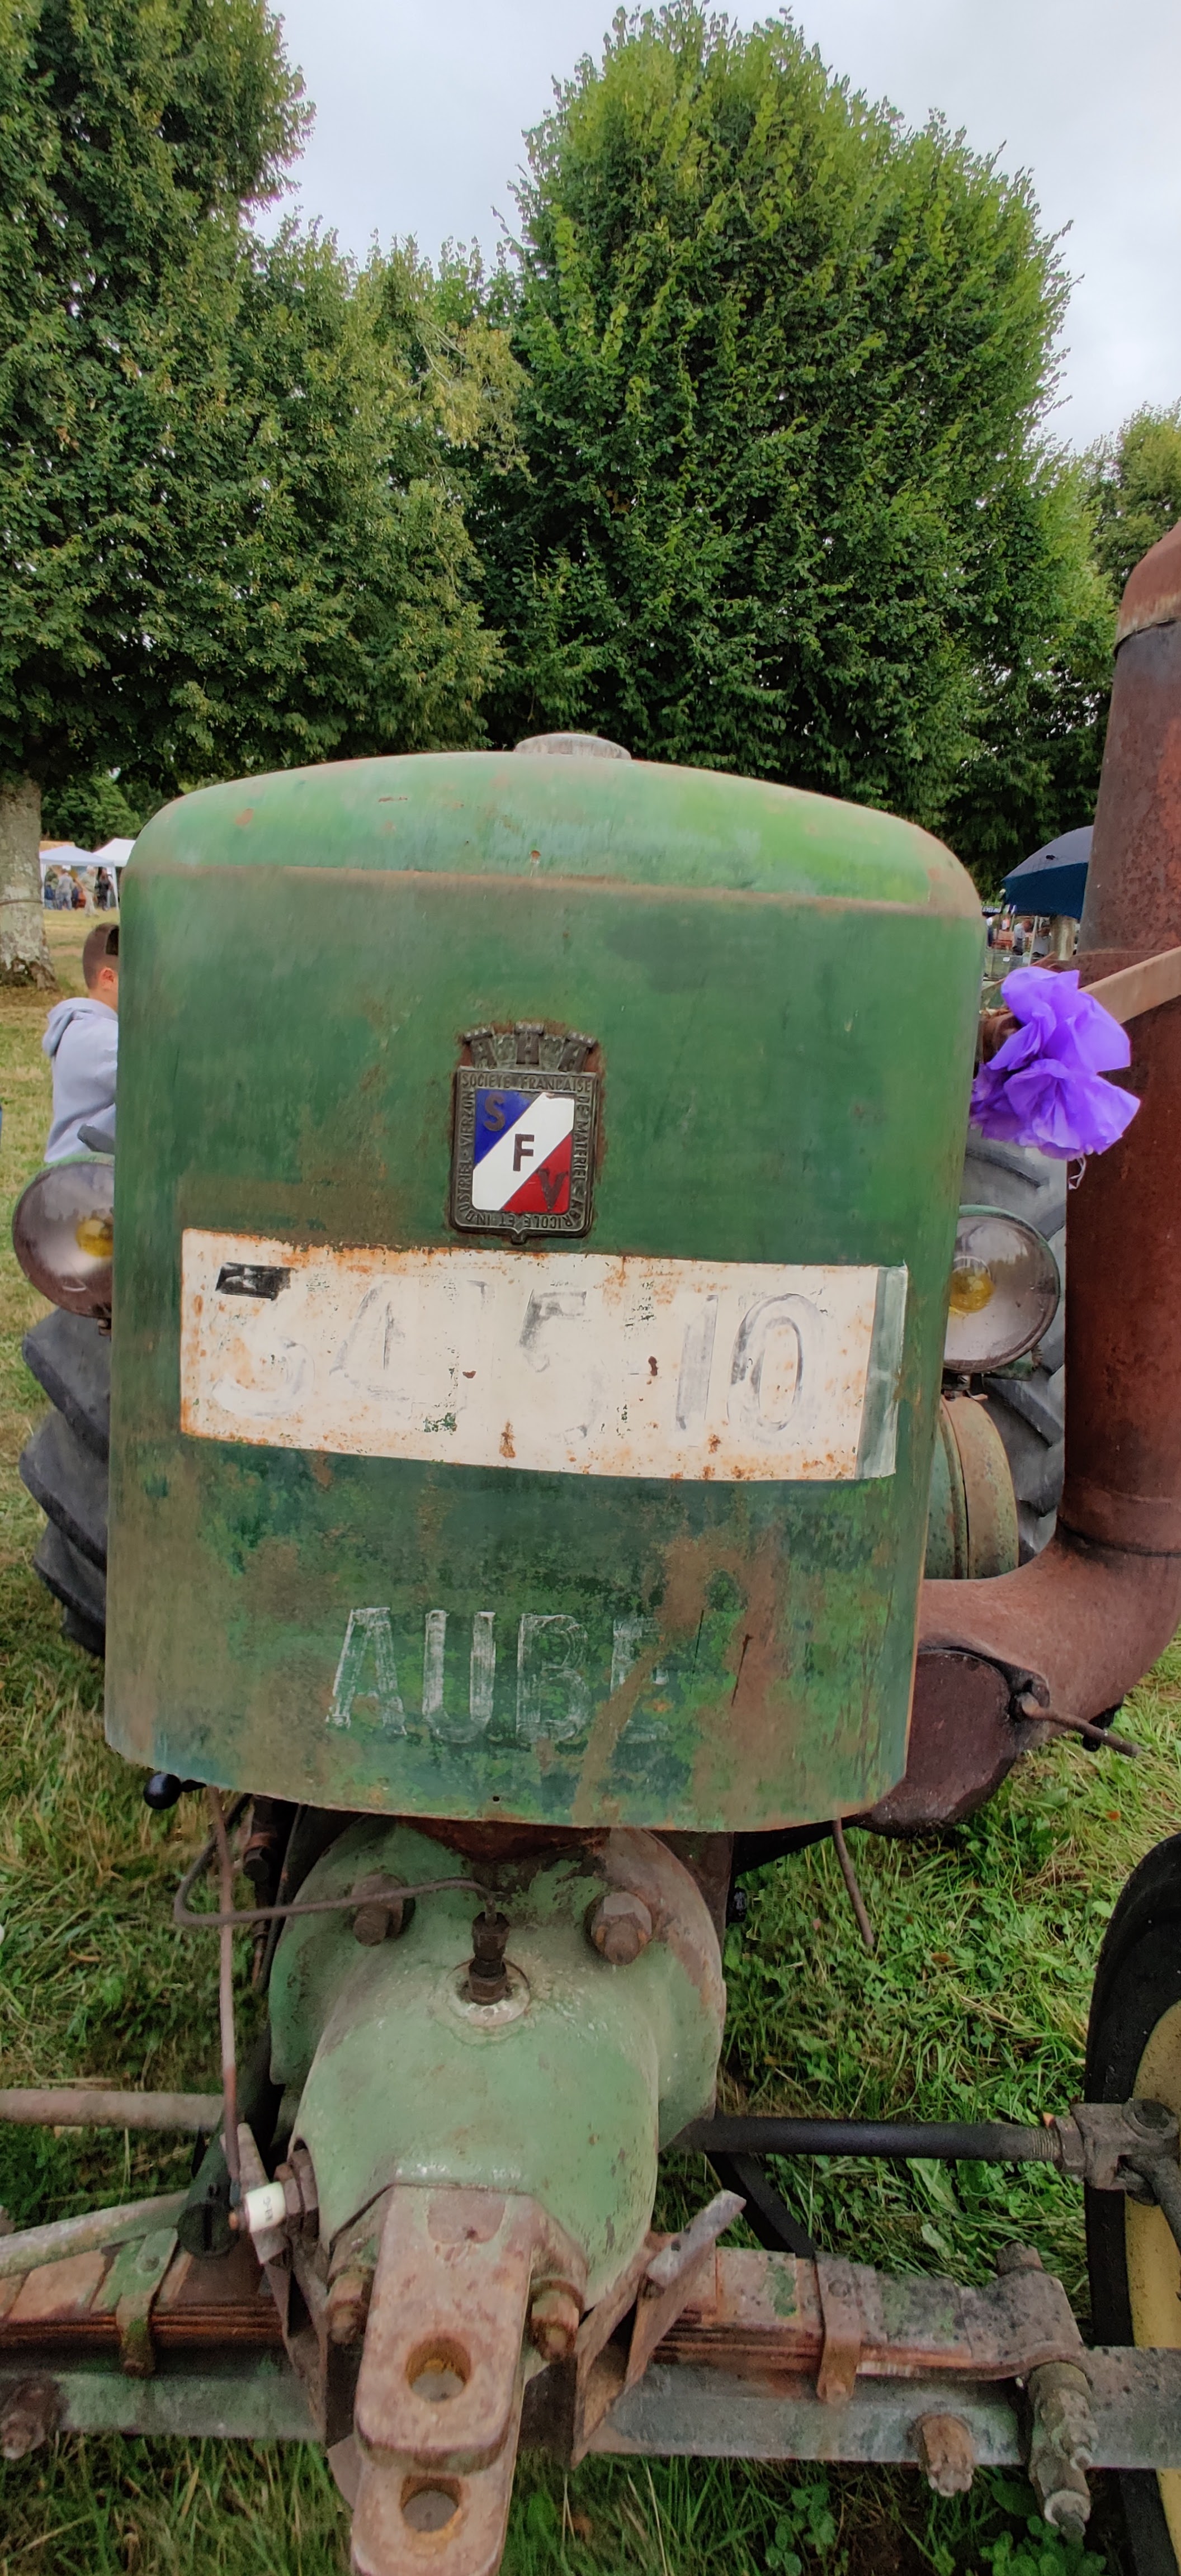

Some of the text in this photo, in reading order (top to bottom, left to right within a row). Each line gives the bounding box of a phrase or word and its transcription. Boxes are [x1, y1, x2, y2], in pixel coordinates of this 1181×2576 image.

[576, 1095, 590, 1117] DE
[459, 1090, 475, 1145] VIERZON
[498, 1213, 516, 1227] ET
